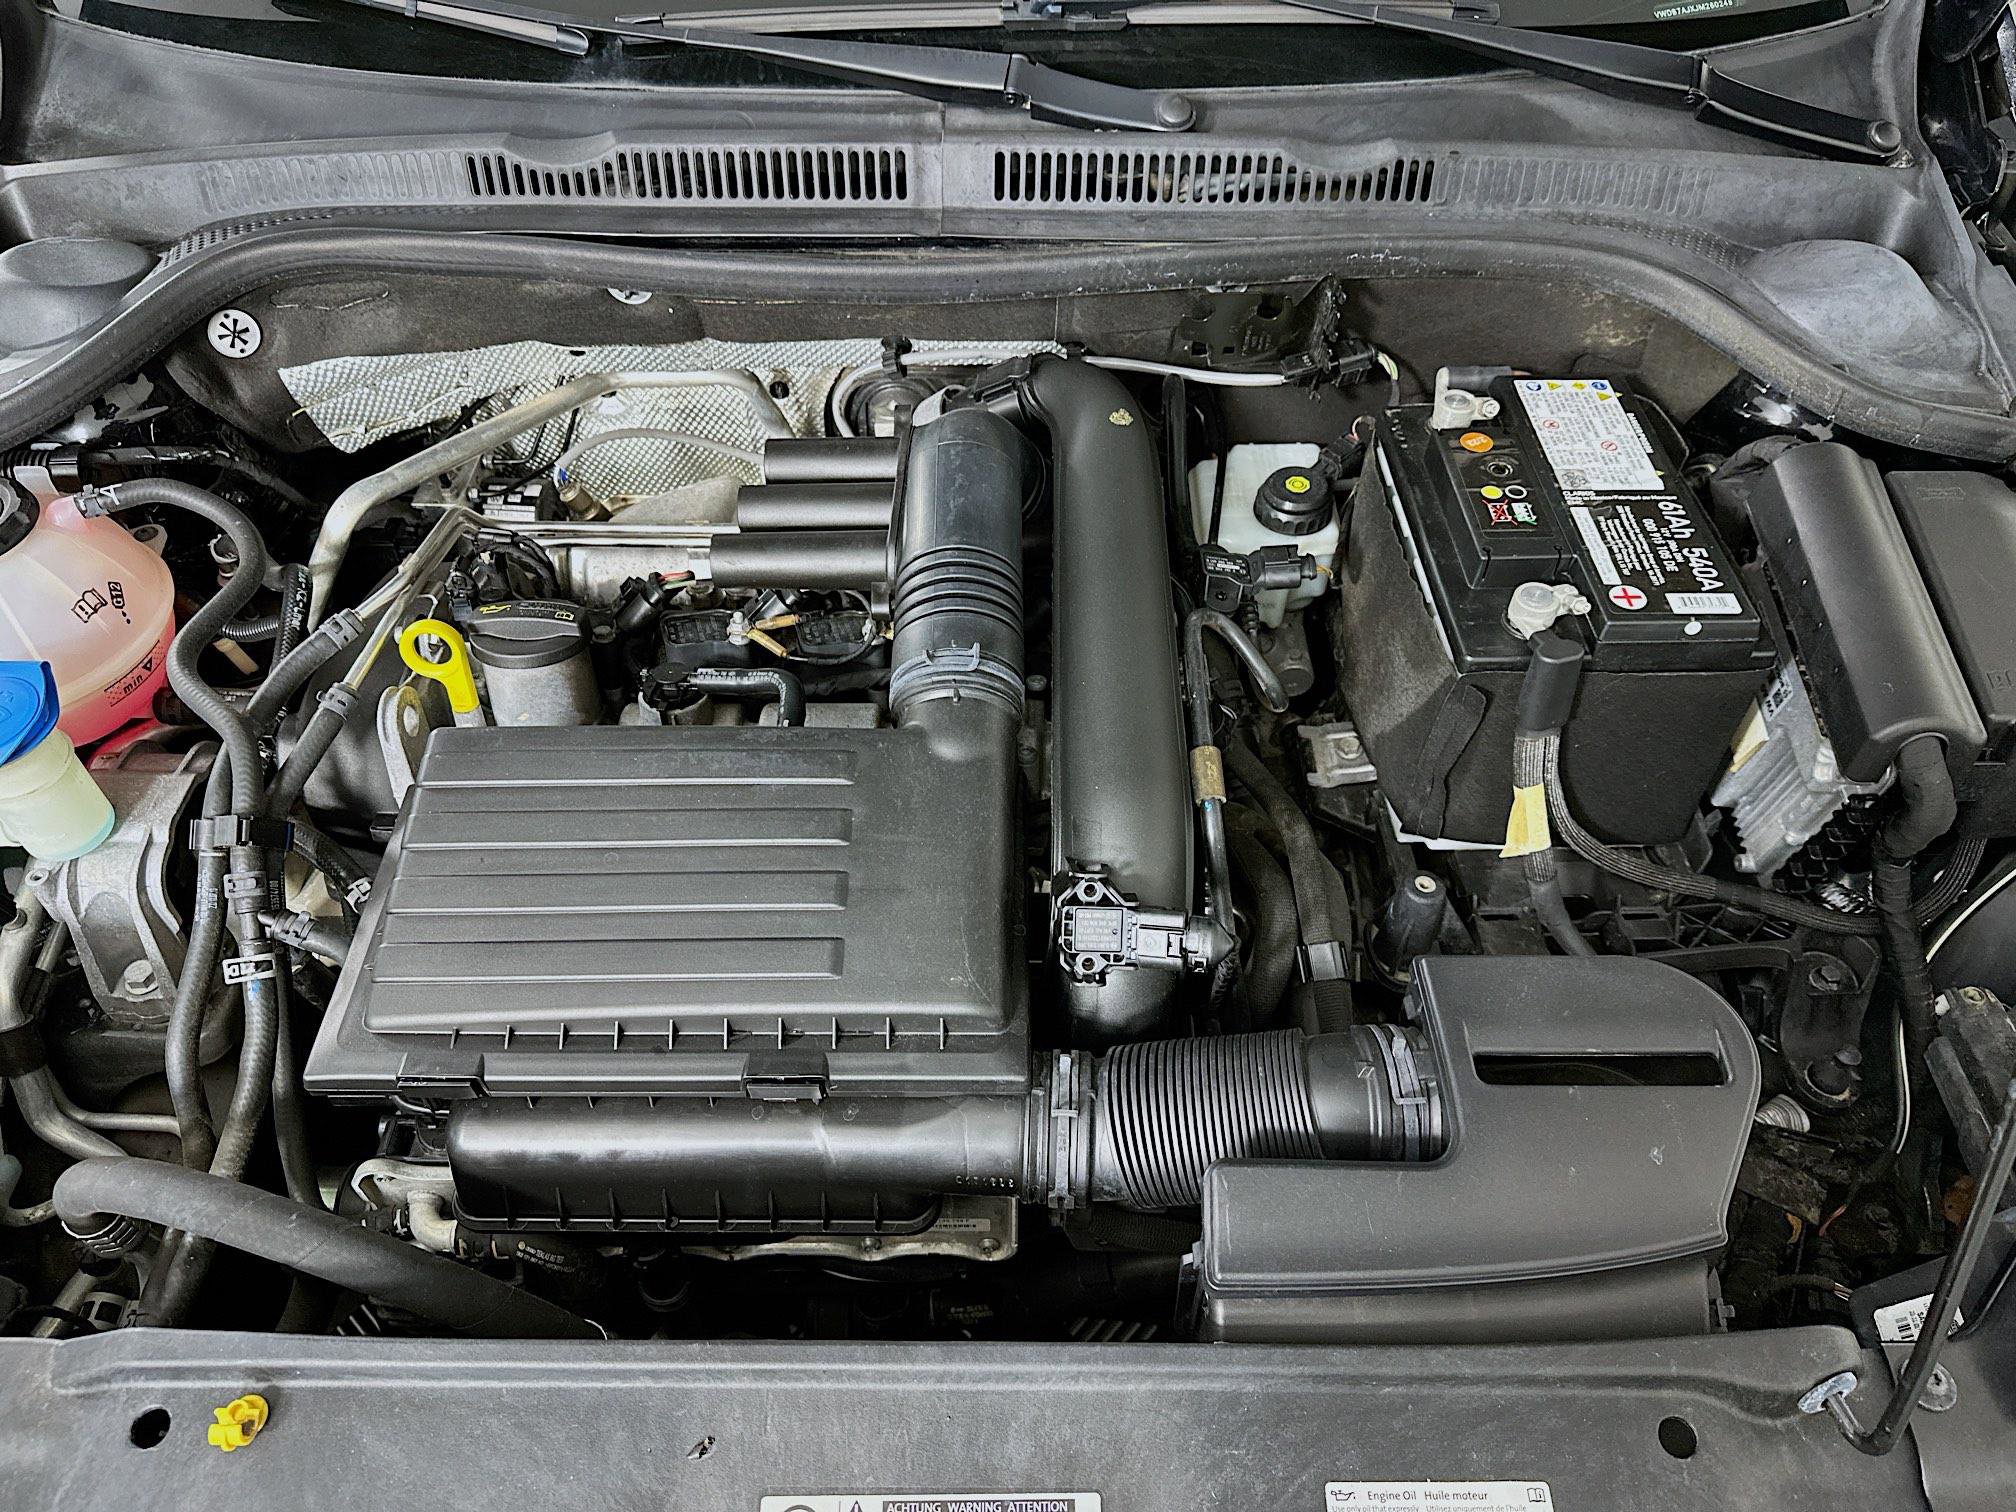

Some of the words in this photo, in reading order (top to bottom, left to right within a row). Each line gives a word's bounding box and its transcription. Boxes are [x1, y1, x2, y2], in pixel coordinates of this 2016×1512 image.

[1658, 501, 1696, 539] 61Ah
[1682, 547, 1724, 591] 540A
[1663, 560, 1679, 572] DE
[109, 583, 123, 606] G12
[123, 674, 143, 695] min
[1367, 1490, 1401, 1503] Engine
[1402, 1490, 1417, 1501] Oil
[1424, 1490, 1450, 1501] Huile
[1452, 1491, 1488, 1501] moteur
[886, 1502, 941, 1512] ACHTUNG
[947, 1502, 1002, 1512] WARNING
[1007, 1501, 1068, 1512] ATTENTION
